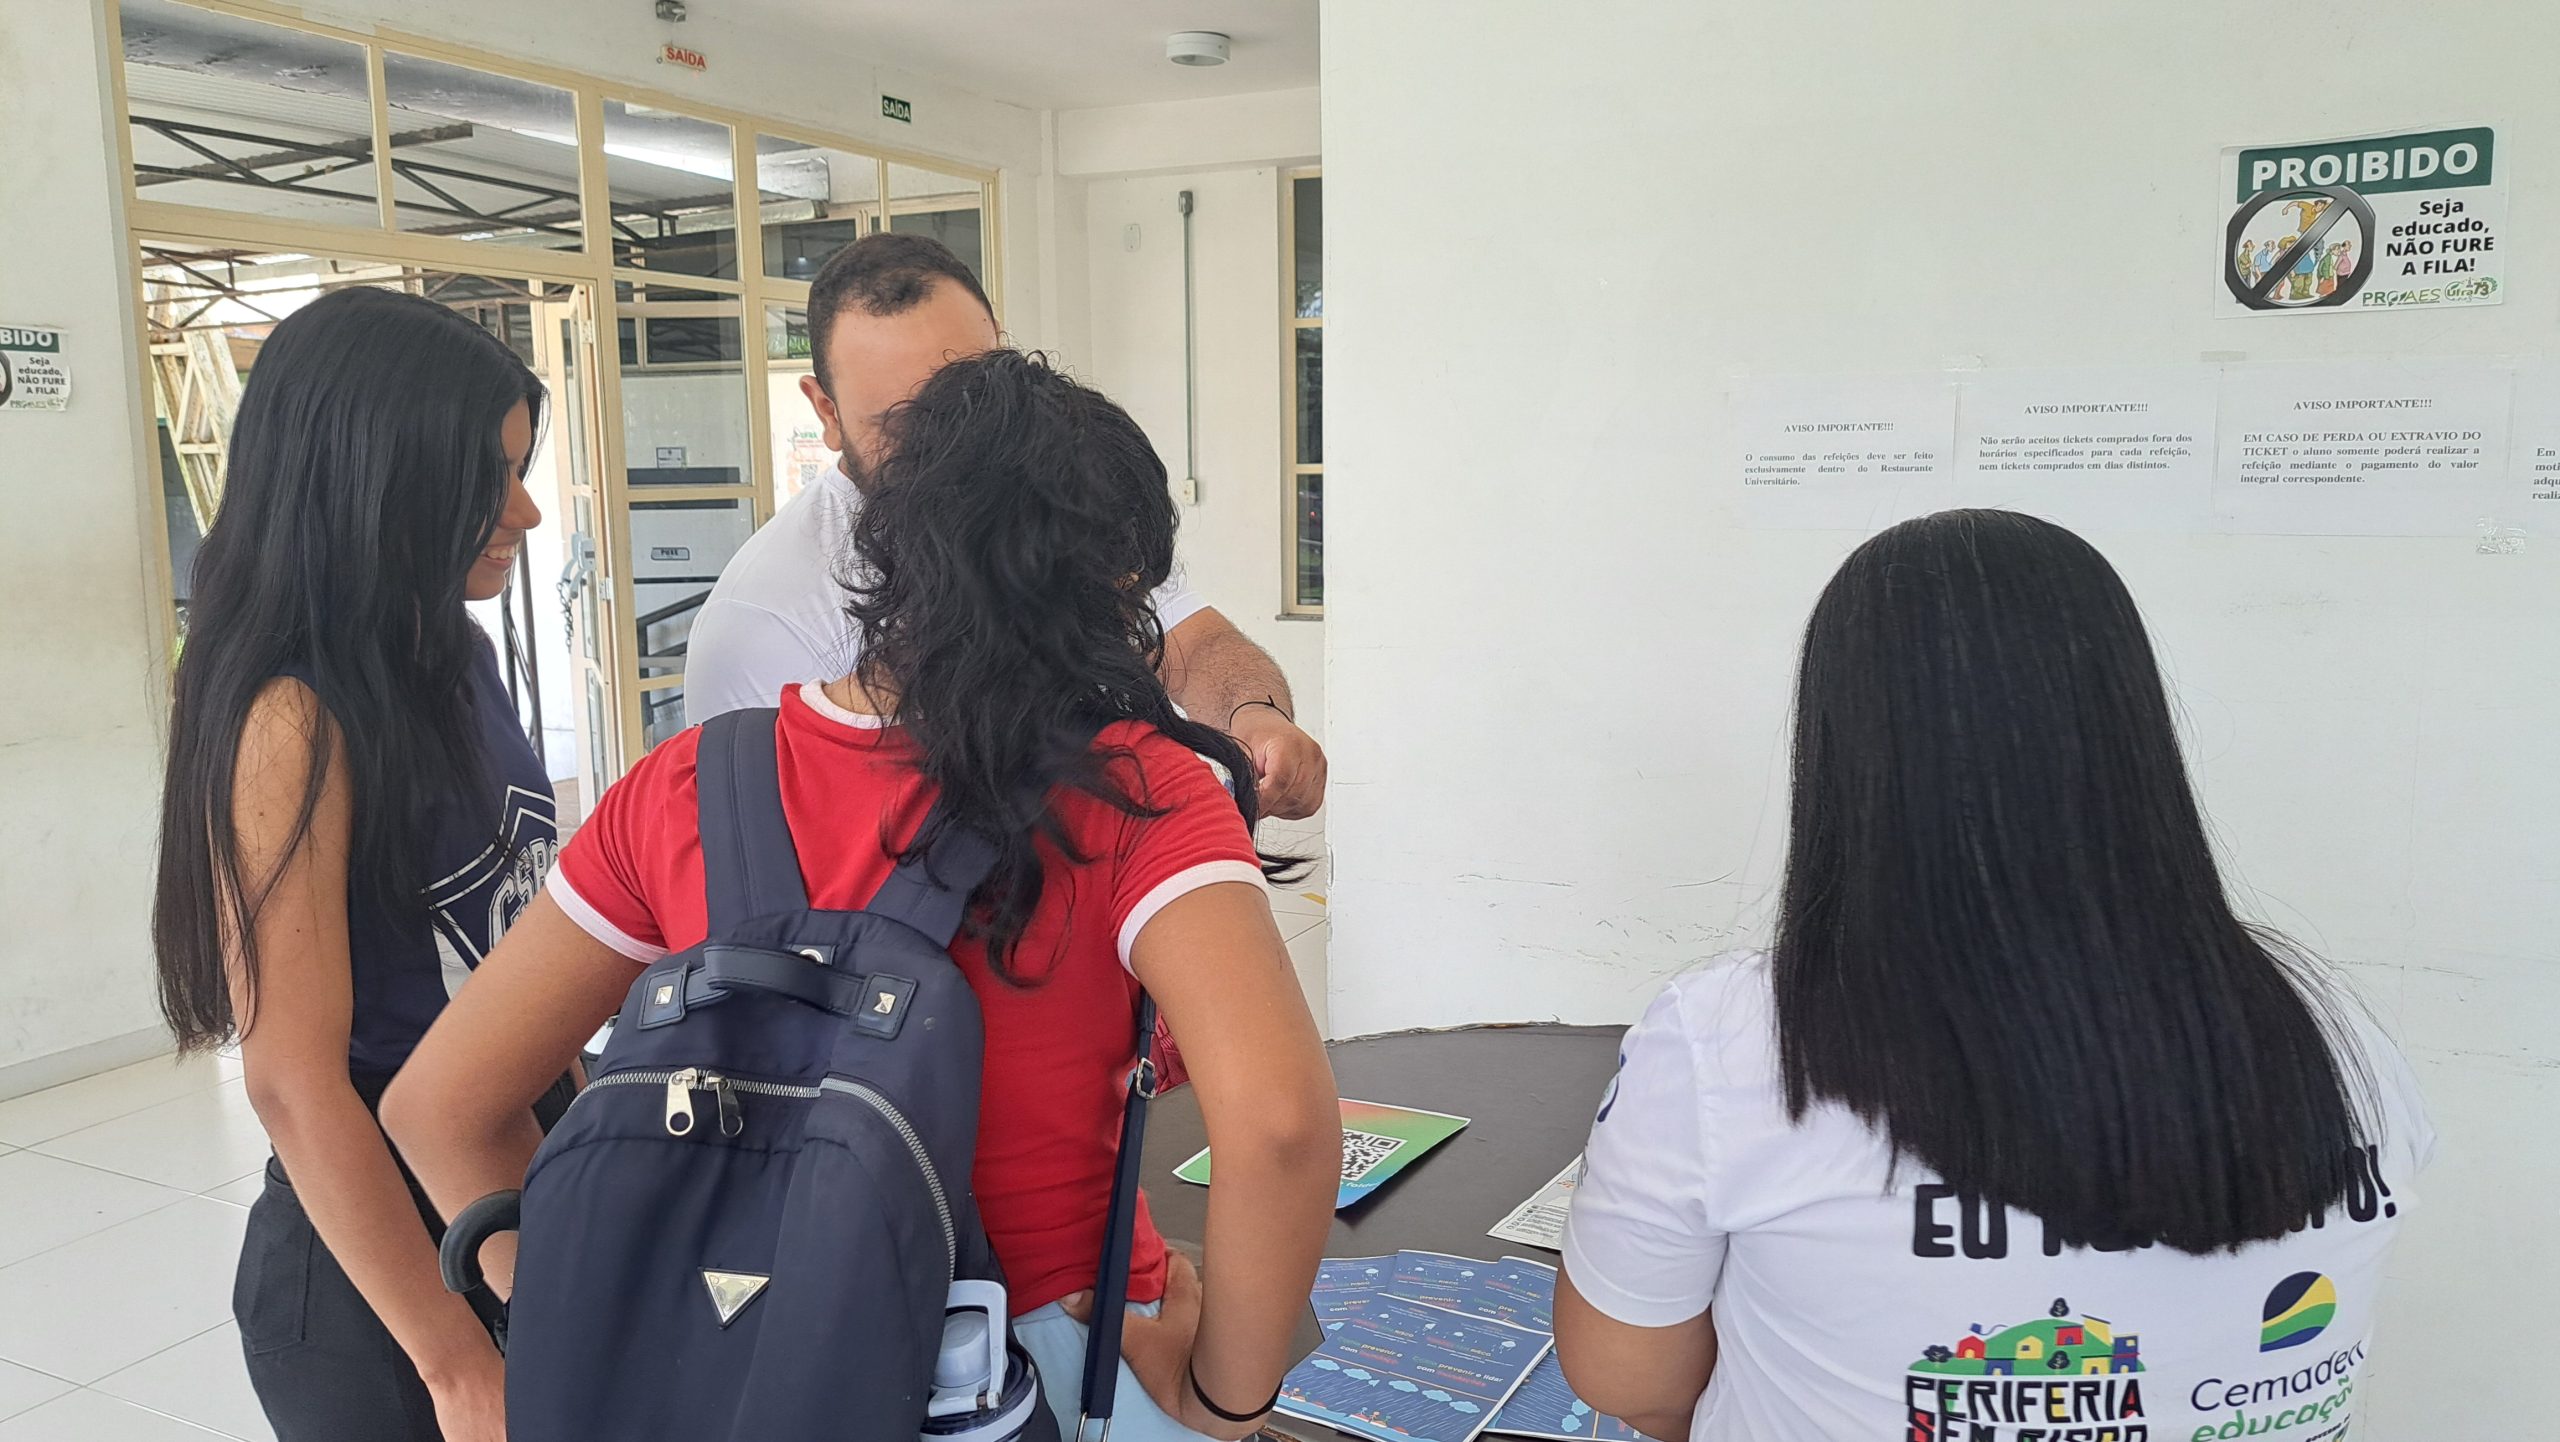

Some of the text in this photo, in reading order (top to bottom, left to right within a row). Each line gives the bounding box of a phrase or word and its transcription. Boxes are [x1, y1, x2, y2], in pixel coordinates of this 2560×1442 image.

[665, 48, 706, 68] SAÍDA
[883, 97, 910, 120] SAÍDA
[2252, 142, 2478, 191] PROIBIDO
[2419, 198, 2464, 218] Seja
[2391, 219, 2489, 238] educado,
[2386, 237, 2494, 257] NÃO FURE
[2402, 258, 2475, 275] A FILA!
[29, 357, 50, 367] Seja
[19, 367, 62, 376] educado,
[18, 376, 39, 384] NÃO
[2025, 404, 2147, 414] AVISO IMPORTANTE!!!
[2294, 399, 2431, 410] AVISO IMPORTANTE!!!
[1818, 423, 1893, 432] IMPORTANTE!!!
[1981, 434, 2192, 445] Não serão aceitos tickets comprados fora dos
[2244, 432, 2481, 442] EM CASO DE PERDA OU EXTRAVIO DO
[1824, 453, 1859, 462] refeições
[1867, 452, 1886, 460] deve
[1980, 447, 2190, 459] horários especificados para cada refeição,
[2243, 447, 2288, 456] TICKET
[2303, 447, 2332, 455] aluno
[2384, 446, 2421, 457] poderá
[2427, 446, 2468, 454] realizar
[2537, 448, 2556, 456] Em
[2001, 462, 2030, 470] tickets
[2033, 461, 2084, 471] comprados
[2105, 461, 2123, 469] dias
[2127, 461, 2169, 469] distintos.
[2242, 461, 2281, 471] refeição
[2290, 461, 2337, 469] mediante
[2361, 461, 2418, 471] pagamento
[2428, 460, 2441, 468] do
[2451, 460, 2479, 468] valor
[1745, 477, 1800, 485] Universitário.
[2241, 475, 2364, 484] integral correspondente.
[1913, 1183, 2007, 1259] EU
[1532, 1317, 1550, 1326] com
[1340, 1345, 1358, 1354] com
[1361, 1343, 1396, 1356] prevenir
[1416, 1365, 1436, 1373] com
[1438, 1363, 1474, 1376] prevenir
[1483, 1373, 1503, 1382] lidar
[2191, 1340, 2364, 1411] Cemaden
[1906, 1375, 2146, 1423] PERIFERIA
